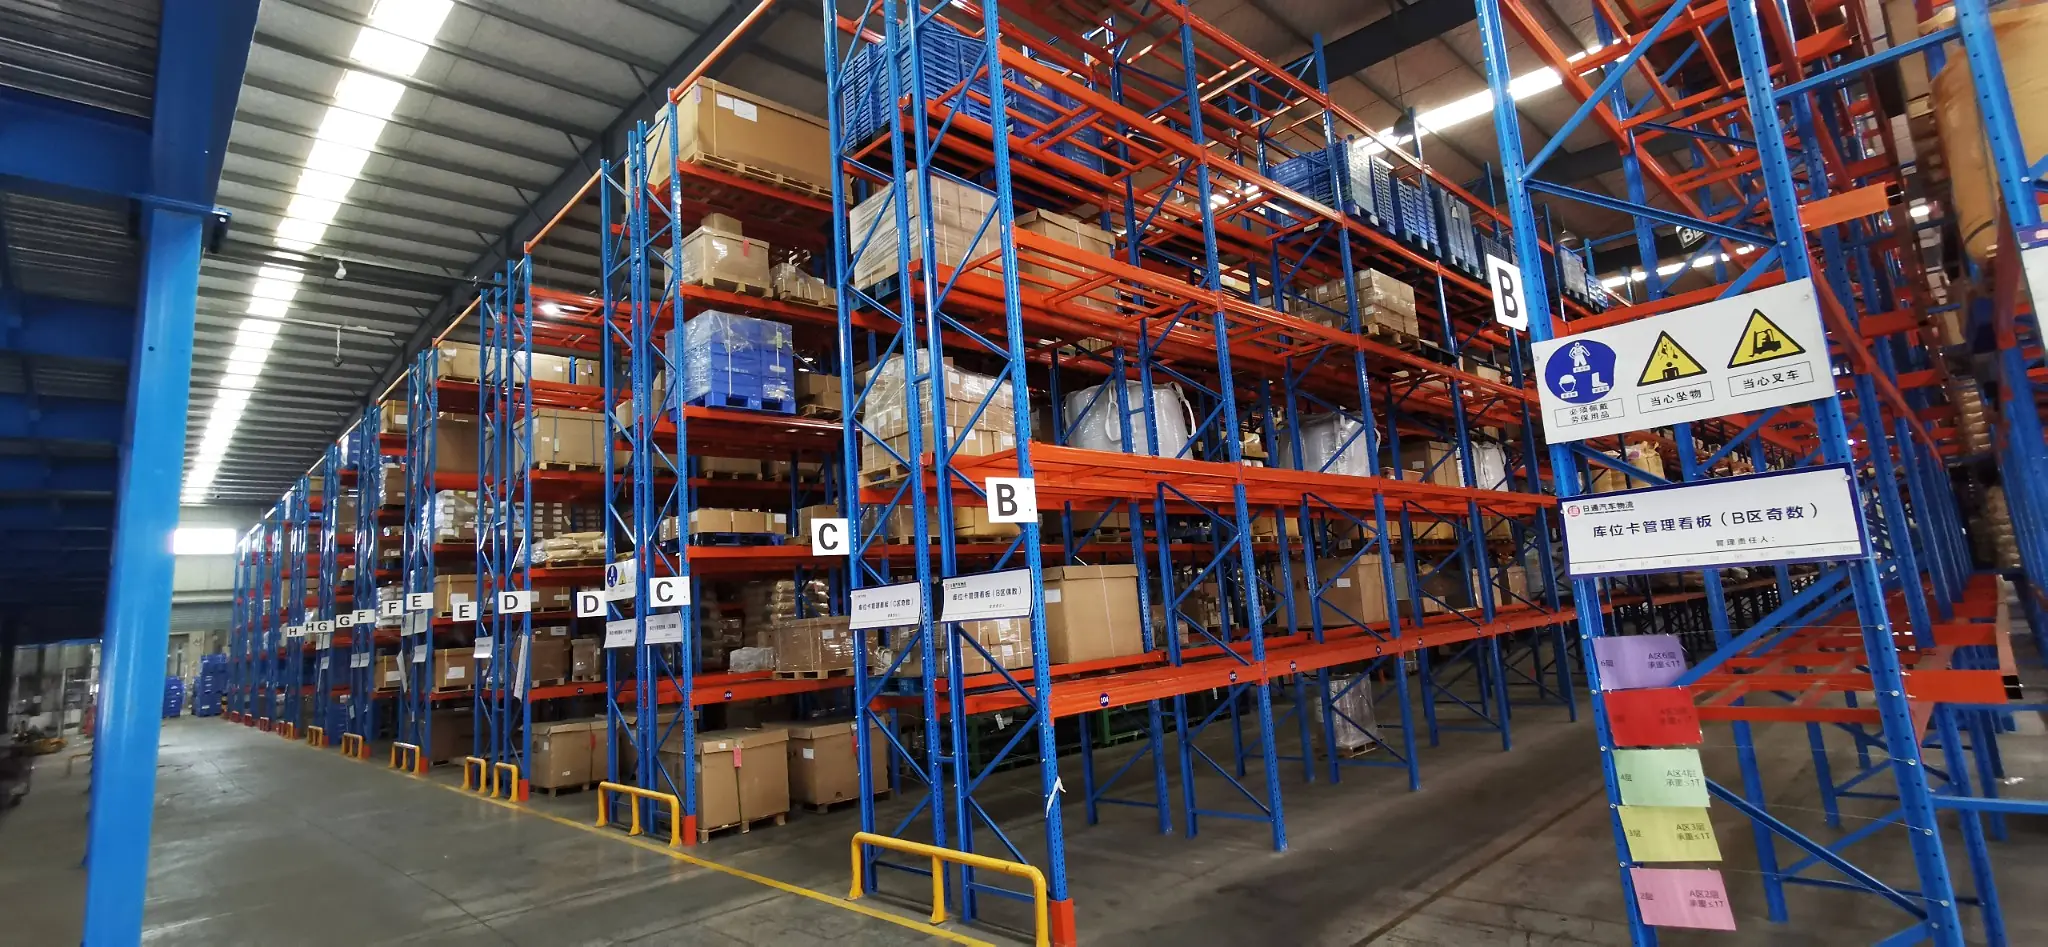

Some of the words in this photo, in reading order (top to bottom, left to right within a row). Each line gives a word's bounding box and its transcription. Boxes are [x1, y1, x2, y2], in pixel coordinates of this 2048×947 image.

[1497, 267, 1518, 318] B
[1743, 370, 1800, 390] 当心叉车
[1651, 389, 1702, 407] 当心坠物
[996, 484, 1017, 516] B
[819, 523, 838, 550] C
[656, 581, 673, 602] C
[388, 603, 397, 613] F
[413, 595, 422, 607] E
[504, 595, 518, 610] D
[583, 595, 599, 613] D
[358, 612, 366, 622] F
[459, 605, 470, 618] E
[317, 621, 328, 631] G
[339, 616, 350, 626] G
[289, 627, 297, 635] H
